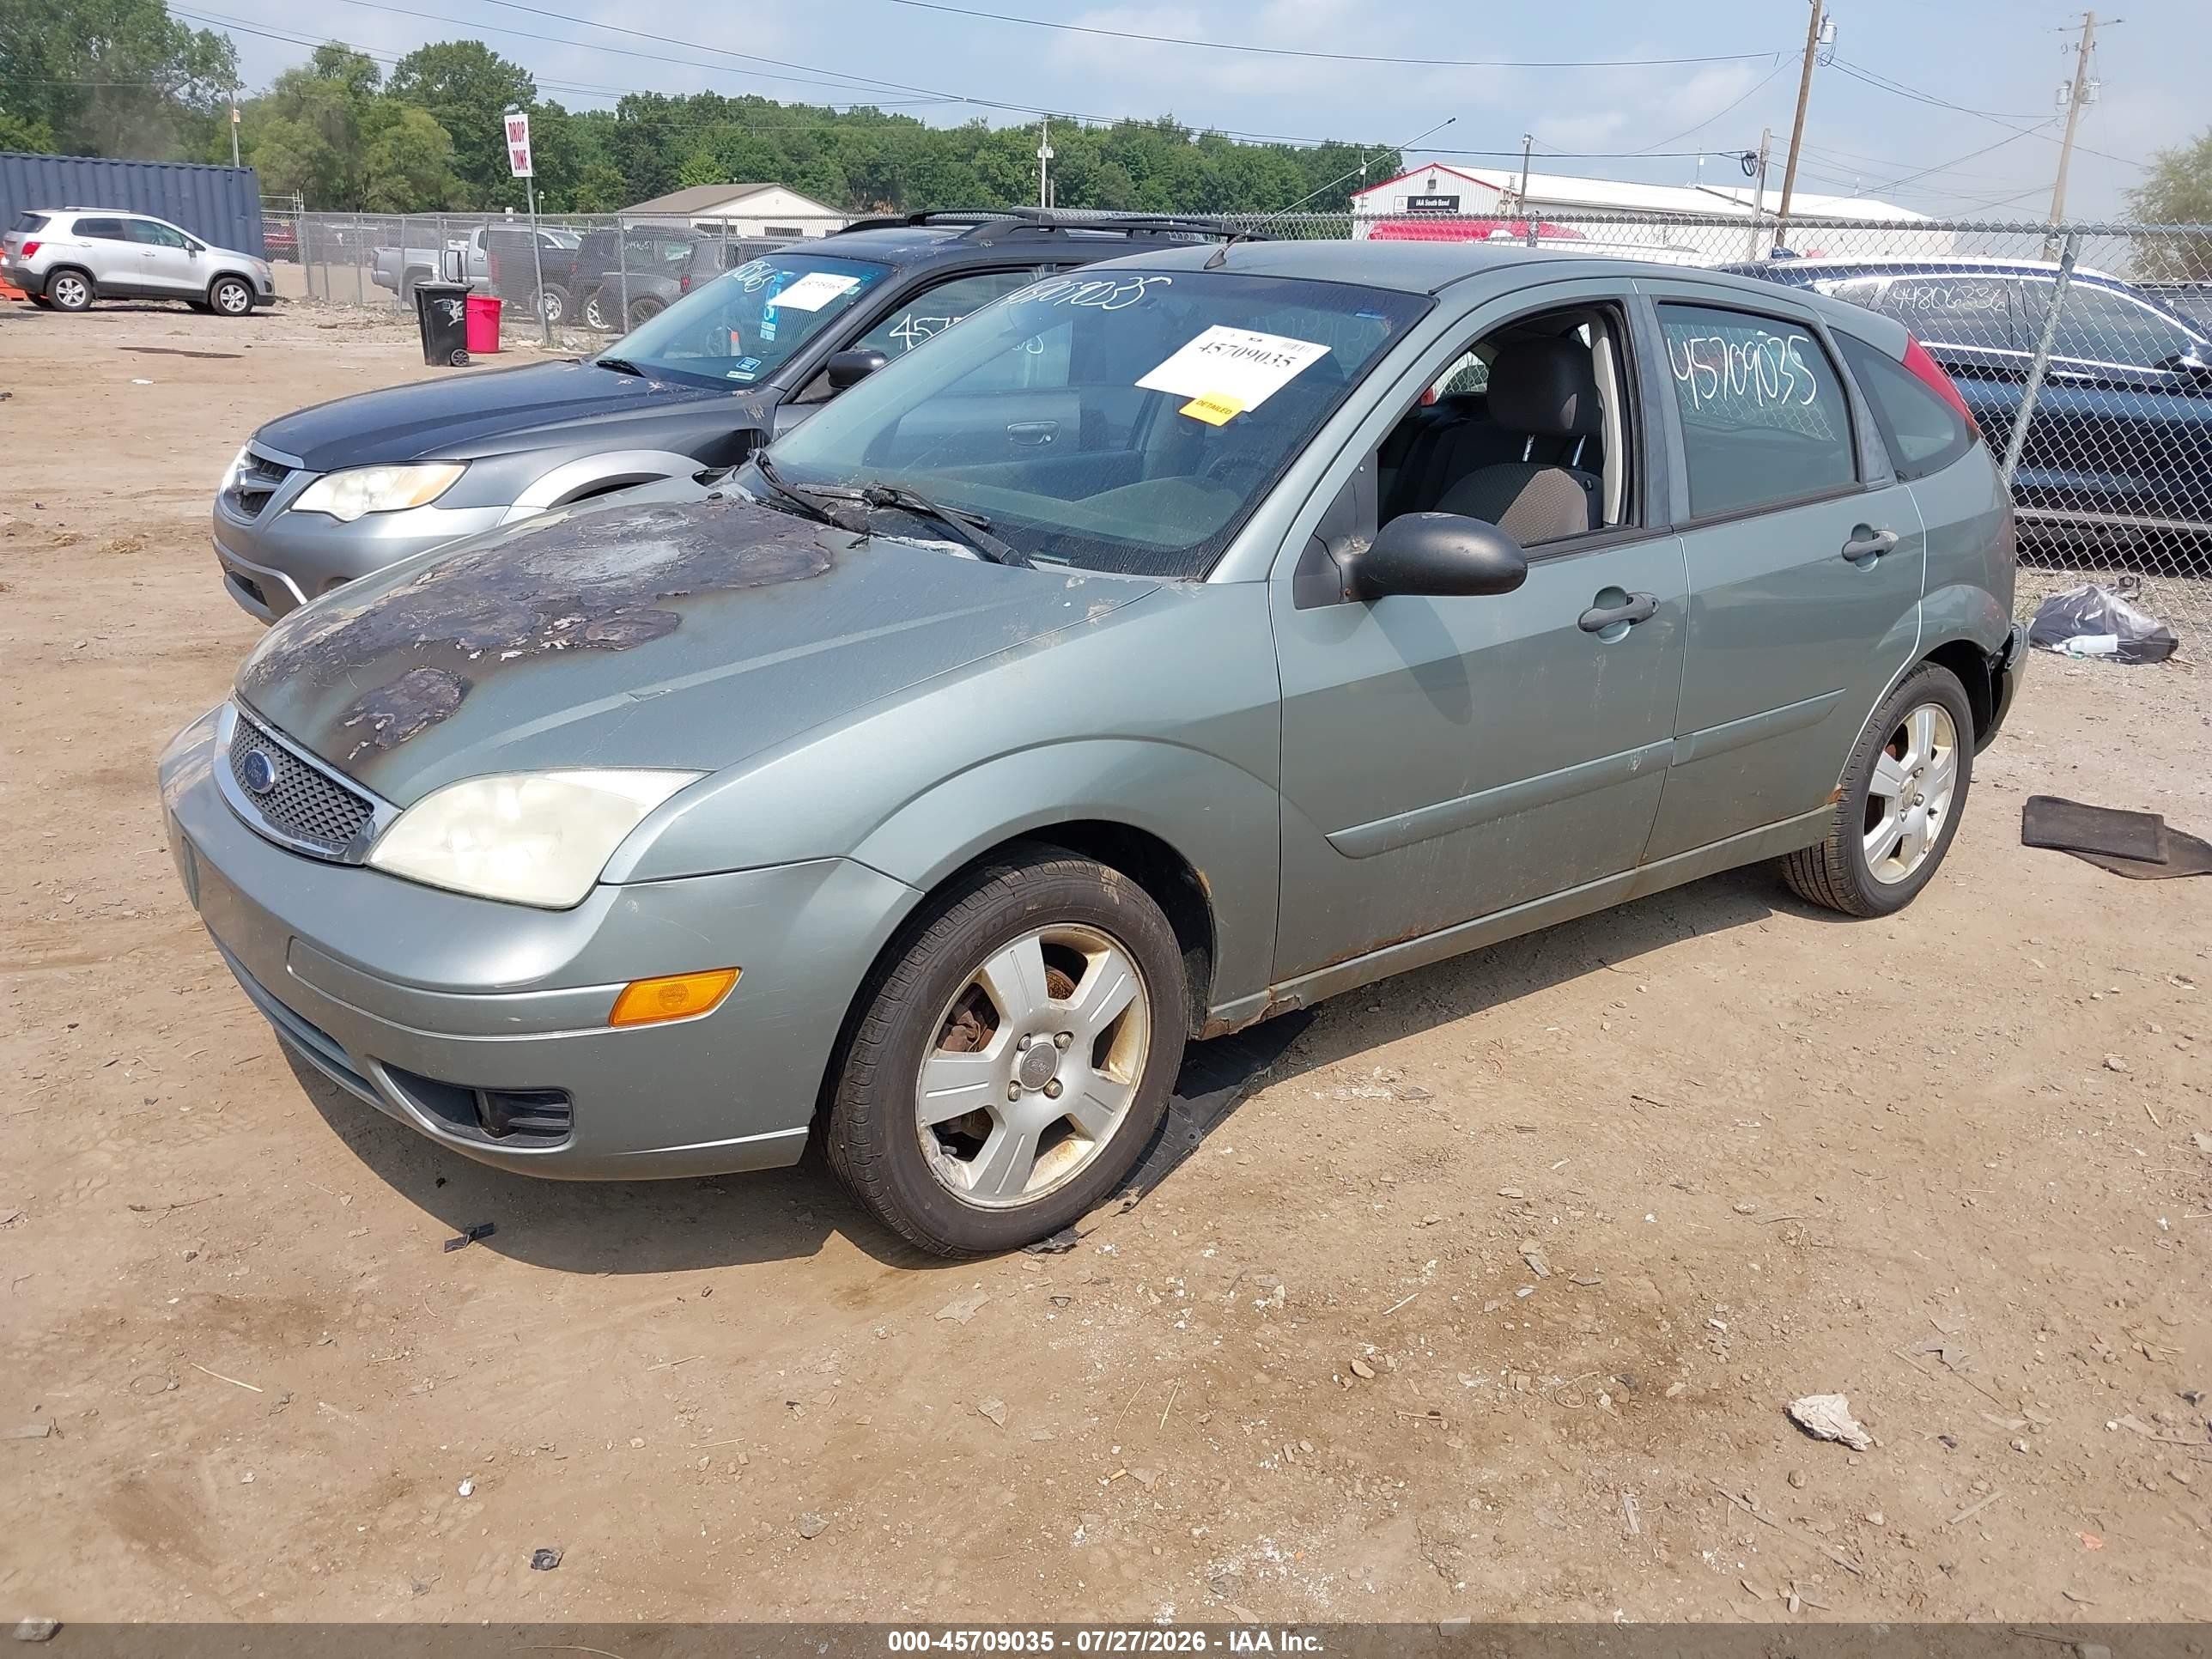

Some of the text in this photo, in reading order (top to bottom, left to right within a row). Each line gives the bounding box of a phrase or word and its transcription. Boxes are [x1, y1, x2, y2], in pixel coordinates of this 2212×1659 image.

[508, 121, 525, 143] DROP
[513, 149, 528, 170] ZONE
[1199, 342, 1297, 368] 45709035
[1667, 334, 1818, 410] 45709035
[1195, 399, 1233, 415] DETAILED
